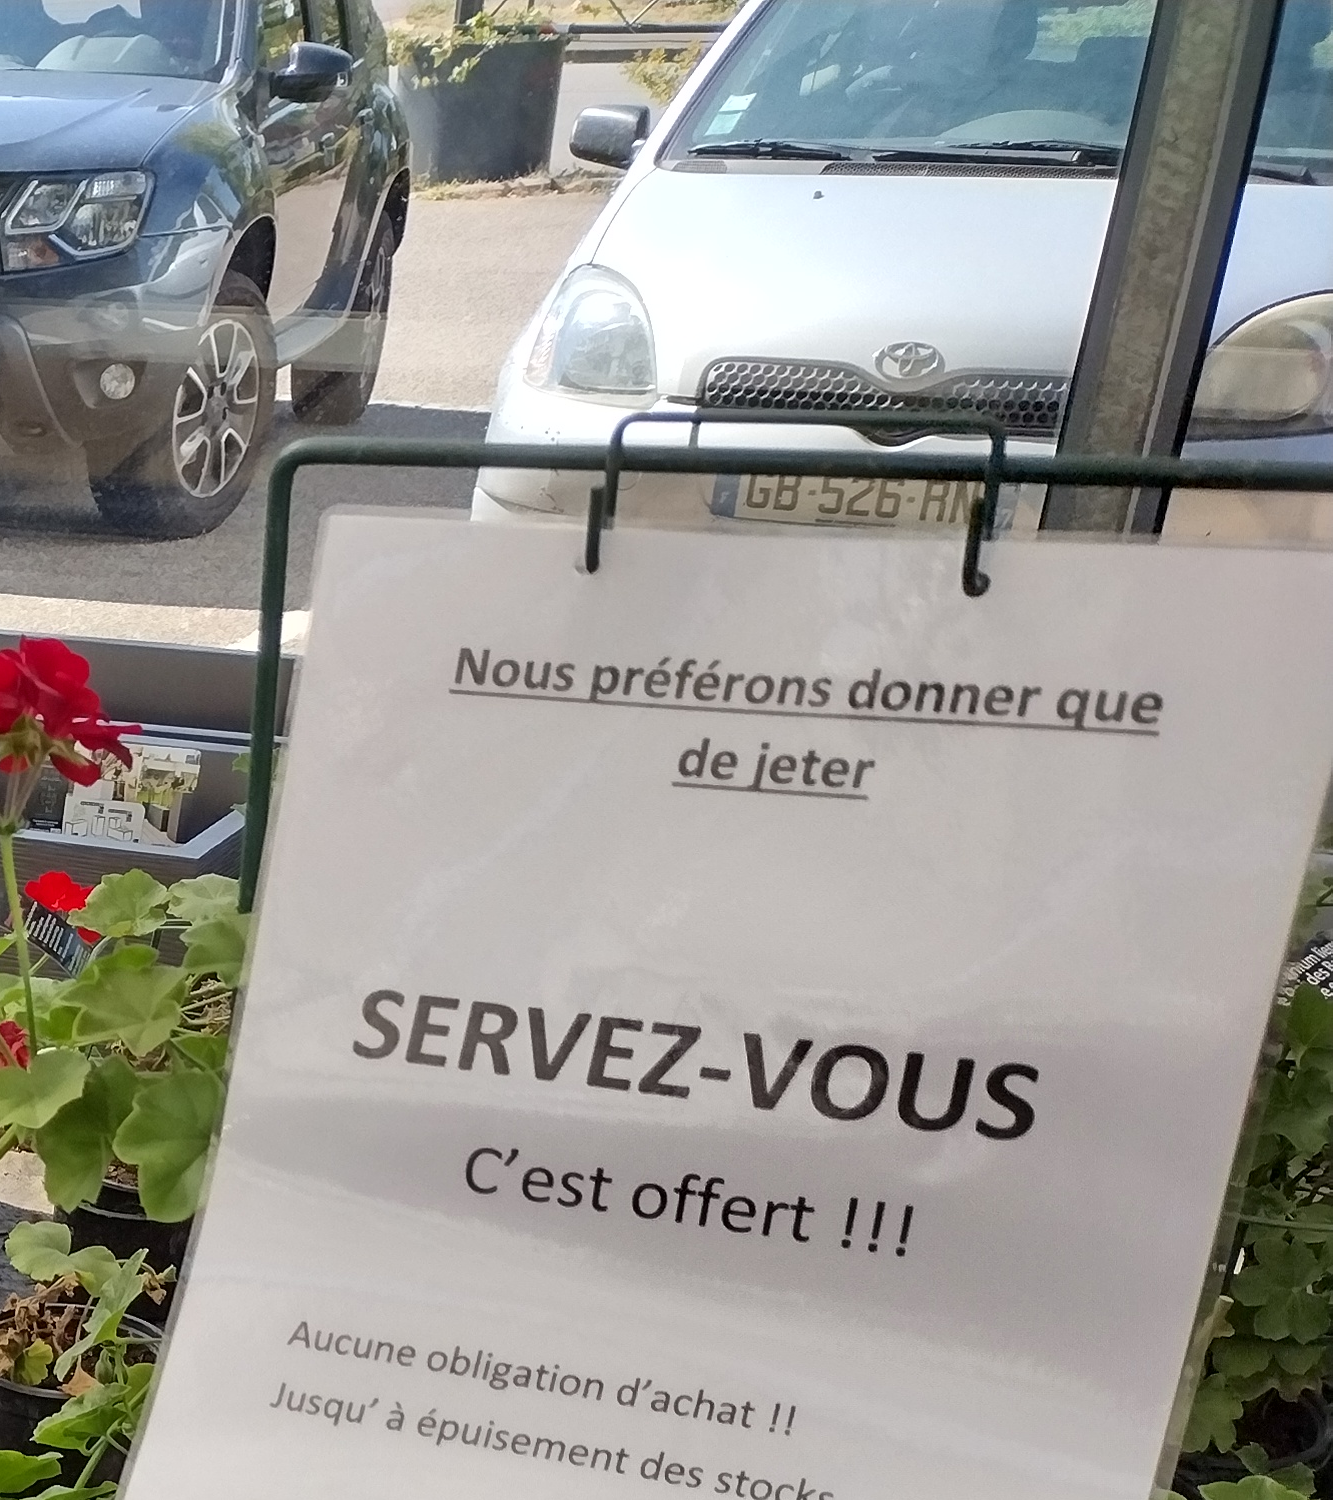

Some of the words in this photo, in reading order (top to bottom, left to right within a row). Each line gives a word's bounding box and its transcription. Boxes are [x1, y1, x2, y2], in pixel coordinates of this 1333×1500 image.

[454, 648, 574, 695] Nous
[592, 656, 830, 710] préférons
[849, 666, 1038, 719] donner
[1056, 687, 1162, 730] que
[678, 740, 736, 782] de
[750, 747, 875, 792] jeter
[352, 989, 1040, 1141] SERVEZ-VOUS
[465, 1147, 613, 1213] C'est
[631, 1172, 816, 1244] offert
[840, 1196, 914, 1258] !!!
[286, 1320, 417, 1368] Aucune
[426, 1345, 605, 1402] obligation
[616, 1377, 756, 1429] d'achat
[768, 1402, 797, 1437] !!
[268, 1381, 380, 1427] Jusqu'
[385, 1401, 405, 1432] à
[416, 1403, 632, 1476] épuisement
[640, 1451, 704, 1489] des
